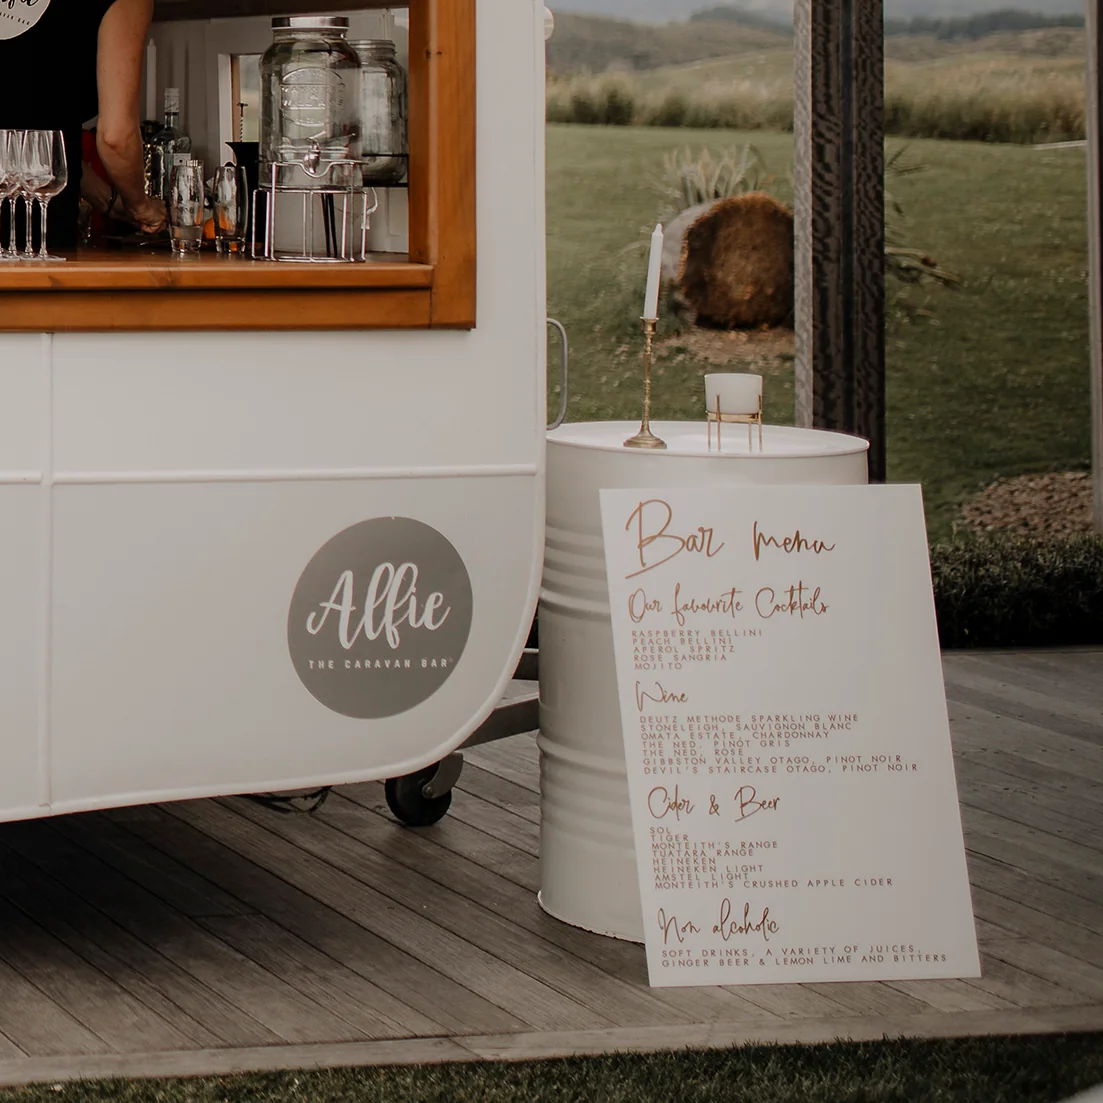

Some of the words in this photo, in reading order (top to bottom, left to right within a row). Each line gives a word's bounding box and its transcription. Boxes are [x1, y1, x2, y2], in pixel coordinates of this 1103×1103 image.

[624, 499, 725, 579] Bar
[753, 520, 836, 562] menu
[306, 562, 451, 650] Alfie
[628, 587, 663, 624] Our
[670, 582, 744, 627] favourite
[754, 580, 830, 619] Cocktails
[631, 629, 700, 637] RASPBERRY
[710, 629, 762, 637] BELLINI
[632, 637, 671, 645] PEACH
[680, 637, 732, 645] BELLINI
[689, 645, 735, 653] SPRITZ
[633, 654, 663, 662] ROSE
[308, 660, 334, 669] THE
[344, 659, 411, 669] CARAVAN
[421, 658, 447, 668] BAR
[634, 662, 683, 670] MOJITO
[634, 680, 690, 712] Wine
[639, 715, 677, 723] DEUTZ
[686, 715, 741, 723] METHODE
[751, 714, 821, 723] SPARKLING
[828, 714, 859, 722] WINE
[640, 724, 725, 732] STONELEIGH,
[736, 723, 805, 731] SAUVIGNON
[814, 722, 852, 730] BLANC
[641, 732, 680, 740] OMATA
[689, 732, 742, 741] ESTATE,
[752, 731, 829, 739] CHARDONNAY
[642, 741, 663, 749] THE
[713, 740, 750, 748] PINOT
[759, 739, 790, 747] GRIS
[643, 749, 664, 757] THE
[714, 748, 744, 756] ROSE
[642, 757, 707, 766] GIBBSTON
[715, 757, 761, 765] VALLEY
[769, 756, 815, 765] OTAGO,
[826, 755, 862, 764] PINOT
[871, 755, 901, 763] NOIR
[644, 766, 699, 775] DEVIL'S
[708, 765, 777, 774] STAIRCASE
[786, 765, 831, 773] OTAGO,
[842, 764, 878, 772] PINOT
[887, 763, 918, 771] NOIR
[647, 784, 696, 821] Cider
[708, 794, 720, 816] &
[734, 785, 781, 822] Beer
[649, 826, 671, 834] SOL
[651, 834, 689, 842] TIGER
[651, 841, 730, 850] MONTEITH'S
[740, 841, 778, 849] RANGE
[652, 849, 707, 857] TUATARA
[653, 857, 716, 866] HEINEKEN
[653, 865, 717, 873] HEINEKEN
[654, 873, 700, 881] AMSTEL
[654, 881, 734, 889] MONTEITH'S
[743, 879, 798, 888] CRUSHED
[807, 879, 845, 887] APPLE
[854, 878, 893, 886] CIDER
[657, 907, 701, 944] Non
[712, 897, 780, 942] alcoholic
[661, 949, 692, 957] SOFT
[701, 948, 755, 957] DRINKS,
[765, 948, 773, 956] A
[781, 947, 836, 956] VARIETY
[843, 945, 859, 953] OF
[869, 944, 921, 954] JUICES,
[661, 959, 710, 967] GINGER
[719, 958, 749, 966] BEER
[758, 958, 766, 966] &
[775, 957, 814, 966] LEMON
[823, 956, 852, 964] LIME
[861, 955, 884, 963] AND
[893, 954, 947, 962] BITTERS
